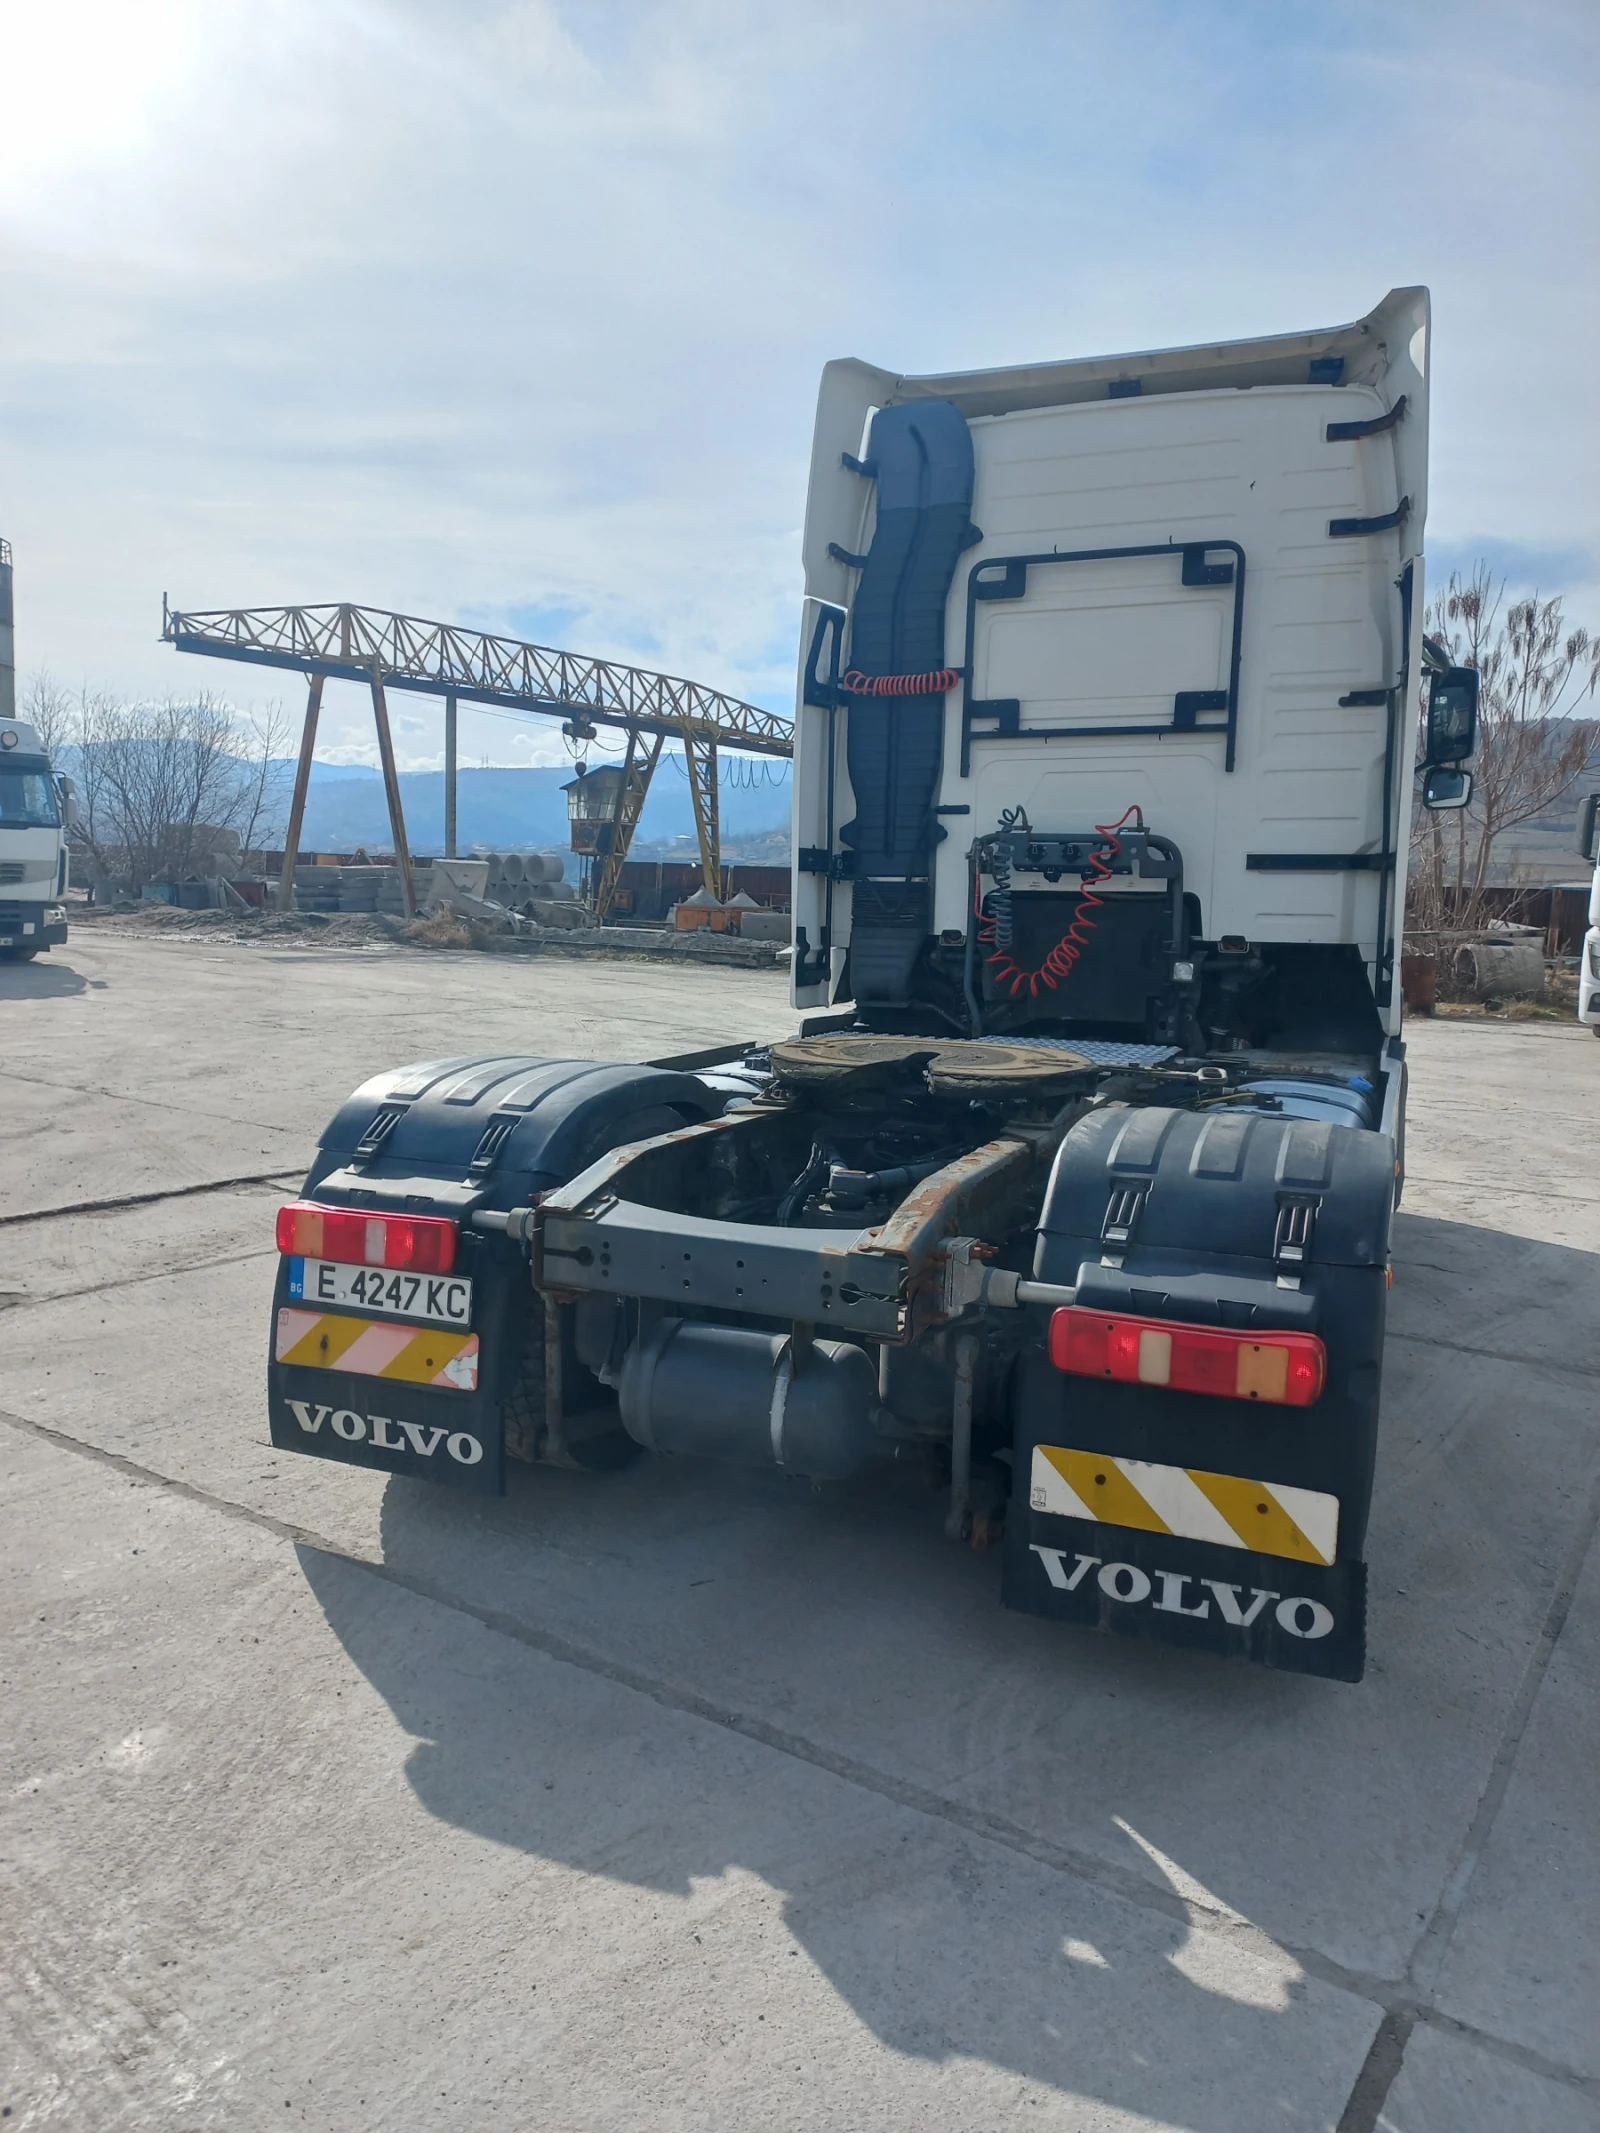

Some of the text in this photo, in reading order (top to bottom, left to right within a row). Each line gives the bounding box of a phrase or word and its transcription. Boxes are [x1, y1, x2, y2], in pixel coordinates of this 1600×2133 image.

[290, 1281, 303, 1293] BG
[318, 1264, 466, 1319] E 4247 KC
[284, 1398, 484, 1465] VOLVO
[1028, 1543, 1335, 1640] VOLVO
